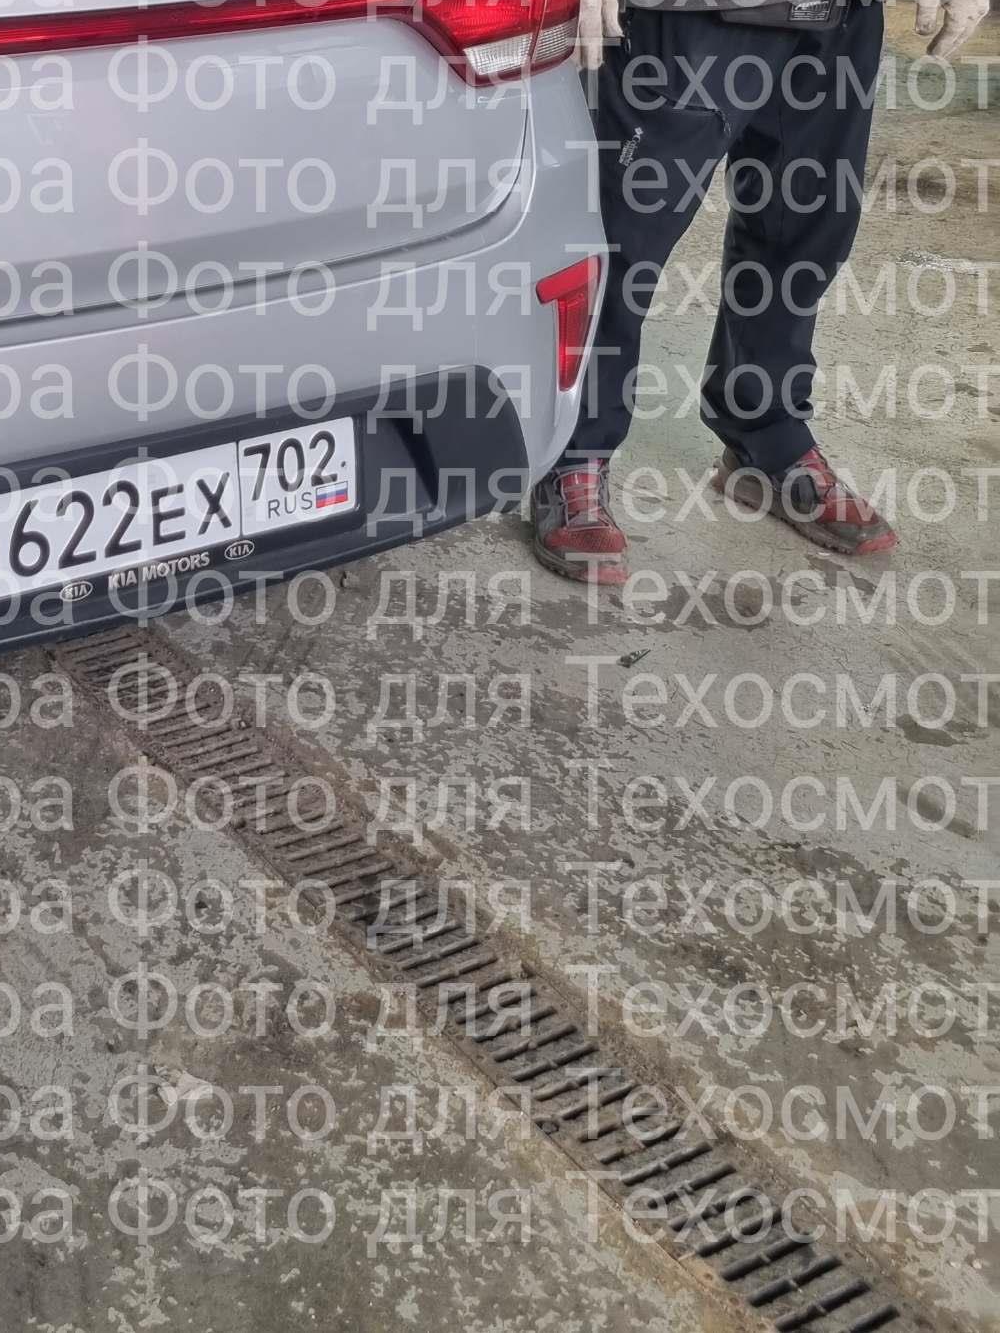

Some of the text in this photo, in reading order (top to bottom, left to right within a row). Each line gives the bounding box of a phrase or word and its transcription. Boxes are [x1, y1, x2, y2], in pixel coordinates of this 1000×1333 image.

[243, 429, 338, 502] 702
[267, 494, 313, 519] RUS
[227, 542, 252, 559] KIA
[107, 551, 211, 589] KIA MOTORS
